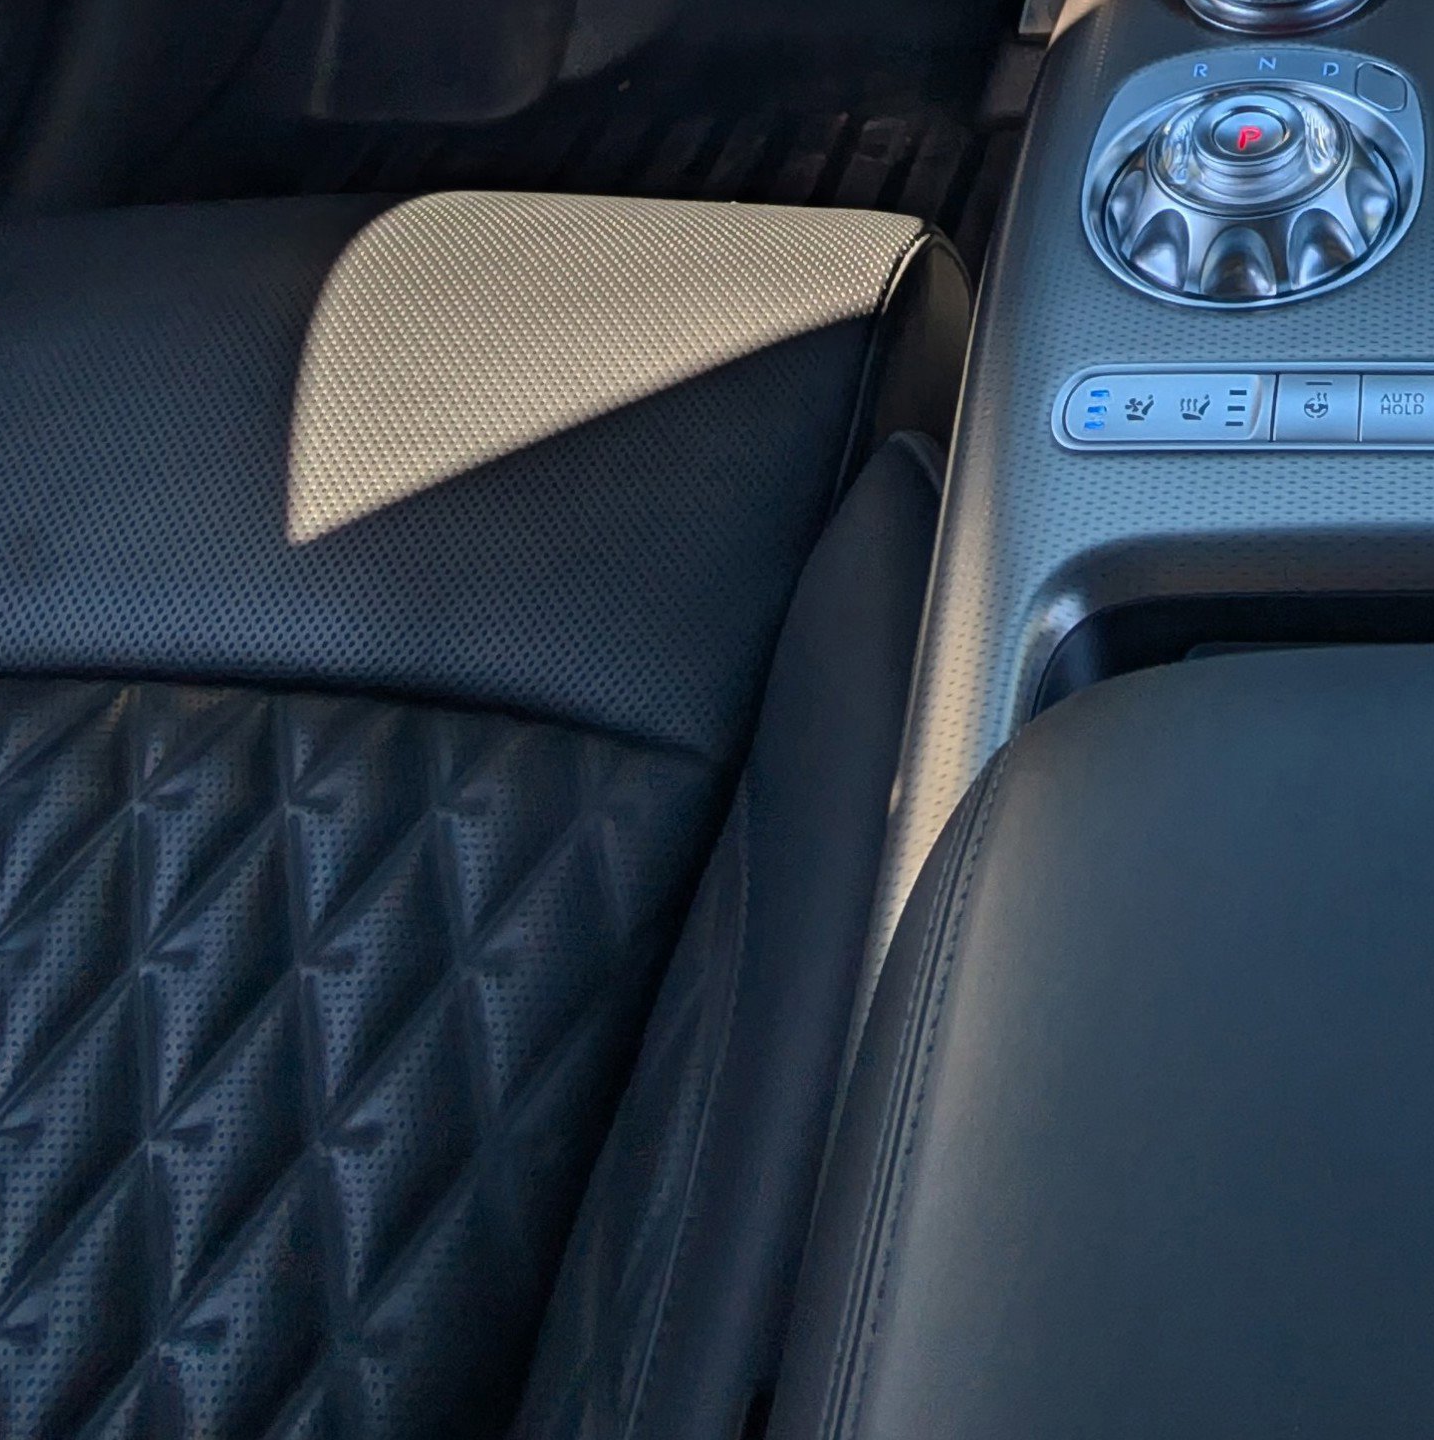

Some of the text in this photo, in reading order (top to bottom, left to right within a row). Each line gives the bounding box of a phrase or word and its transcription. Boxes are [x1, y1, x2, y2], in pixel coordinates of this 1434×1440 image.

[1193, 56, 1340, 78] R N D
[1237, 125, 1262, 151] P
[1380, 392, 1425, 404] AUTO
[1380, 404, 1424, 415] HOLD
